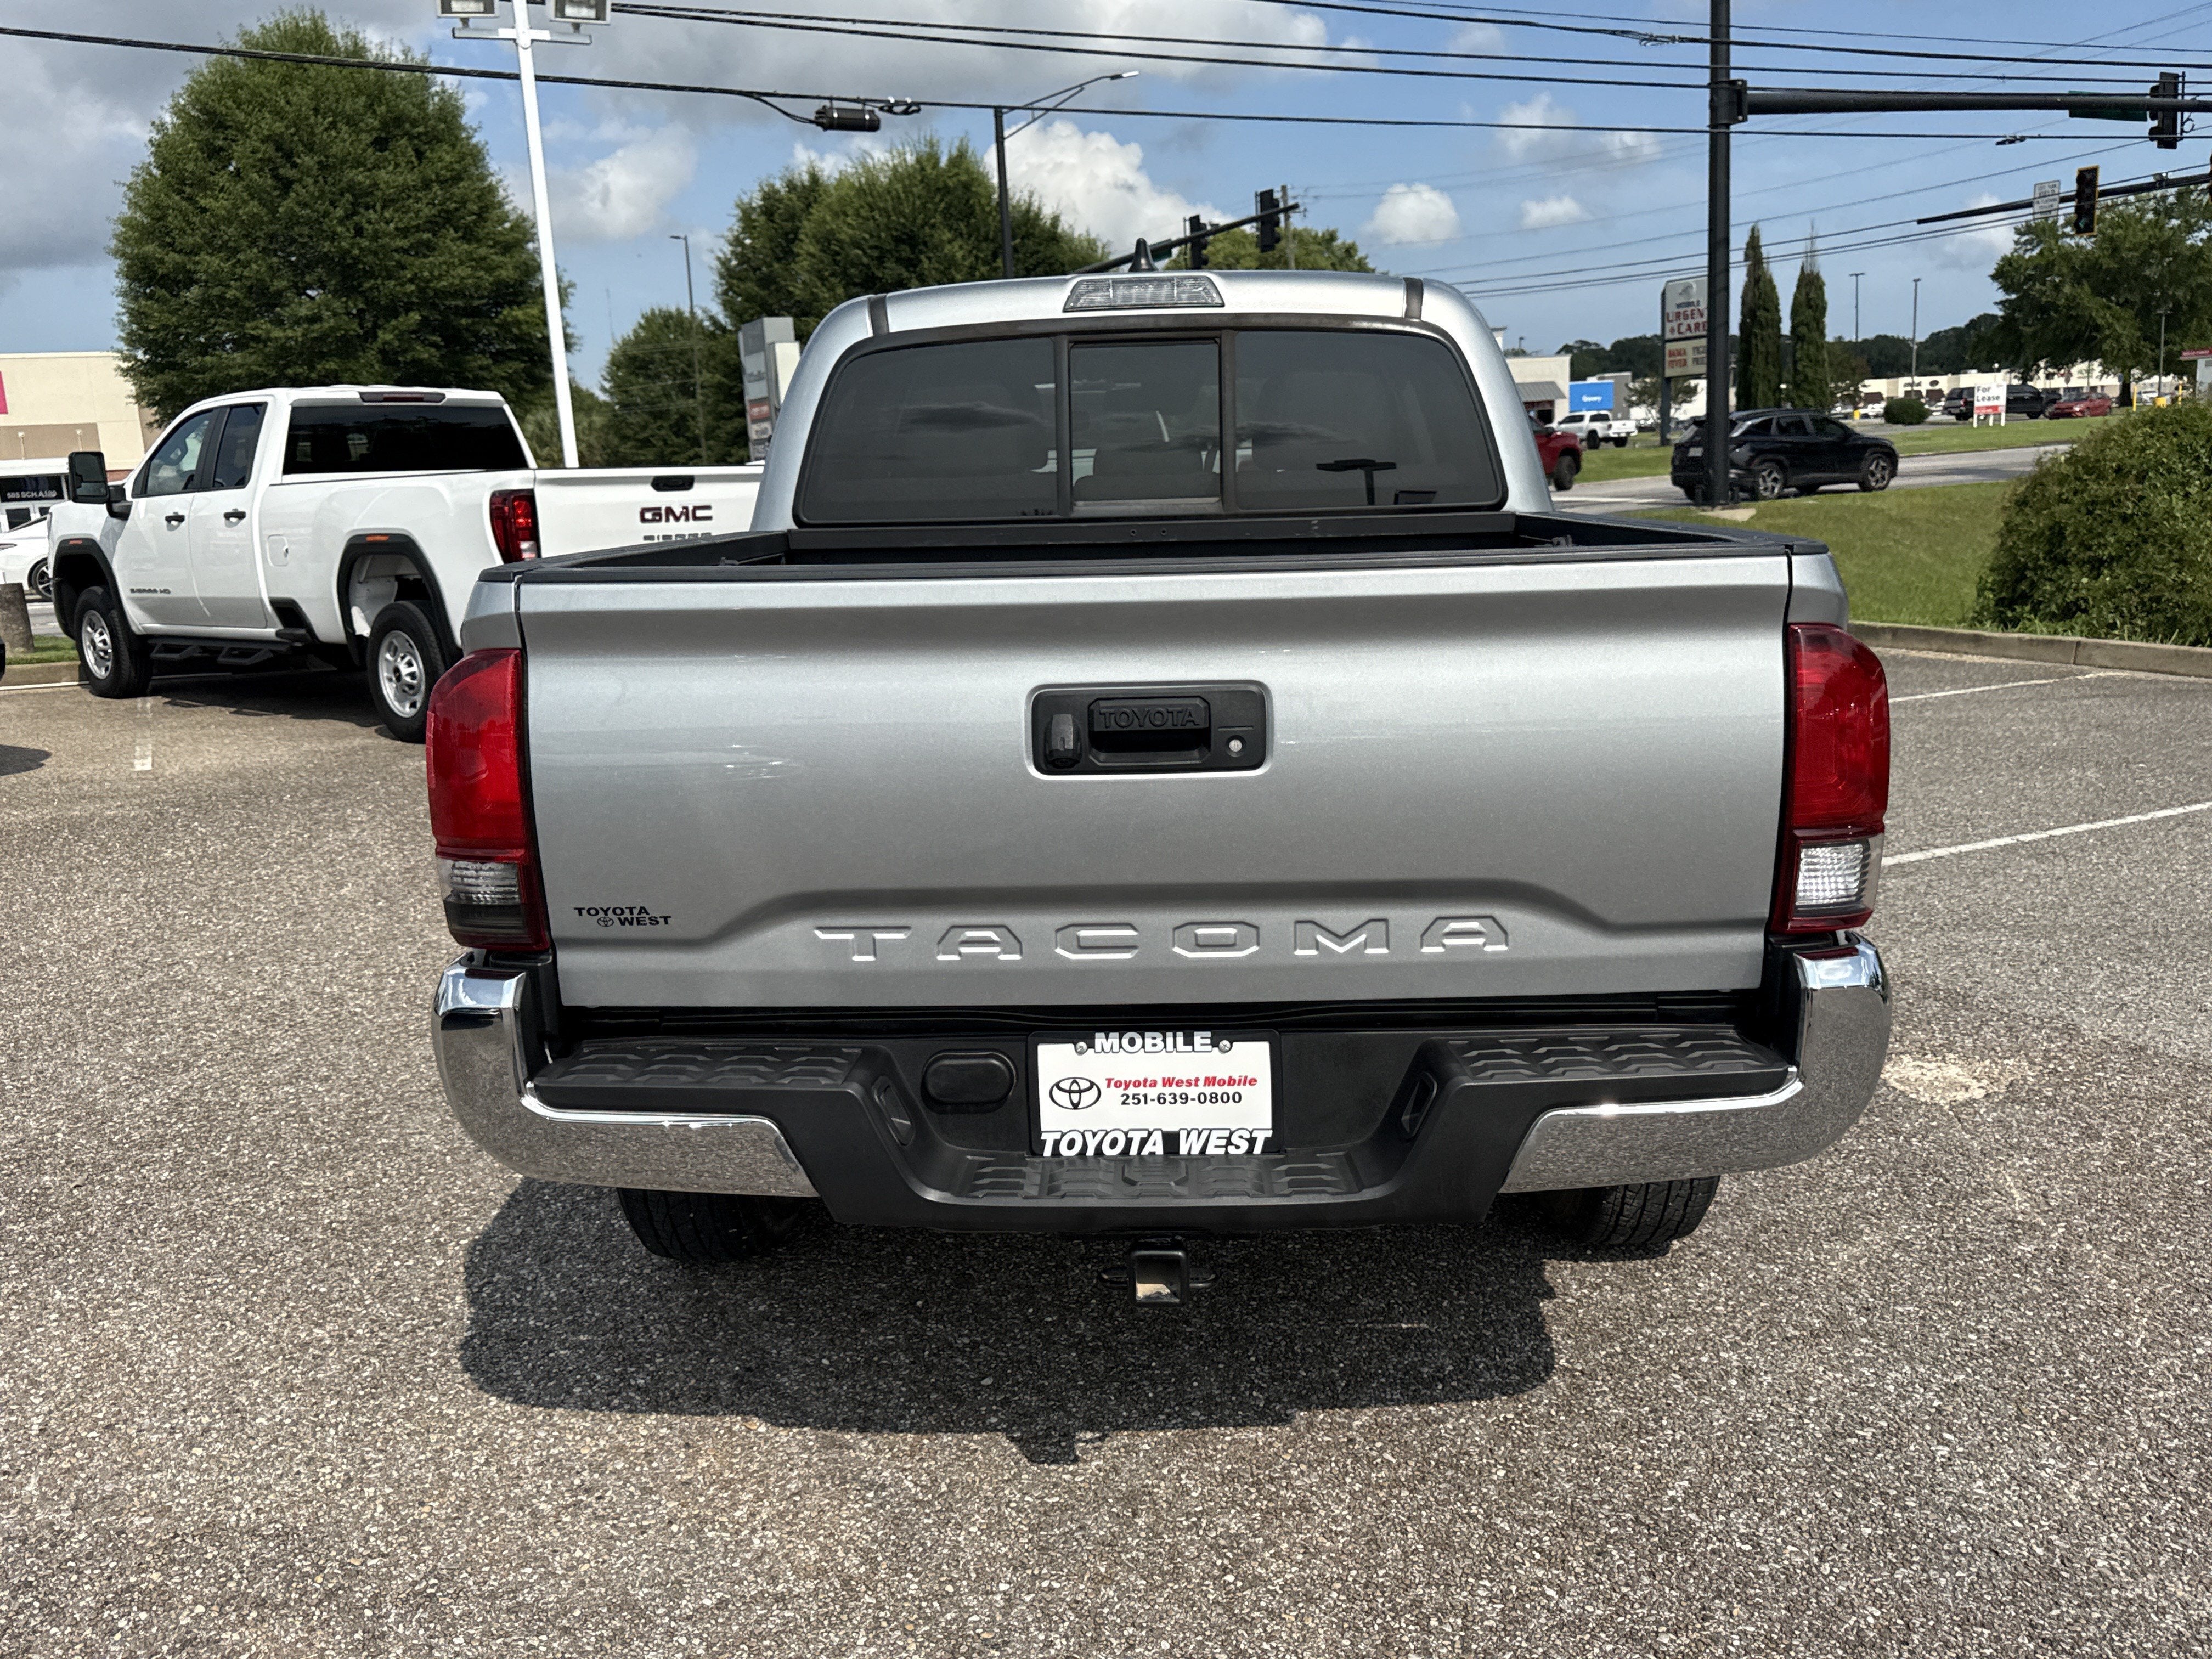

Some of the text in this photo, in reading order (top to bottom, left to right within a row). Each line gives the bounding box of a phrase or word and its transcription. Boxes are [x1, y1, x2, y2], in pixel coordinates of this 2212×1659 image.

[640, 505, 713, 523] GMC
[1099, 707, 1200, 729] TOYOTA
[574, 906, 650, 917] TOYOTA
[618, 916, 672, 926] WEST
[814, 915, 1509, 961] TACOMA
[1094, 1031, 1213, 1053] MOBILE
[1105, 1075, 1257, 1091] Toyota West Mobile
[1120, 1091, 1242, 1105] 251-639-0800
[1040, 1128, 1273, 1157] TOYOTA WEST
